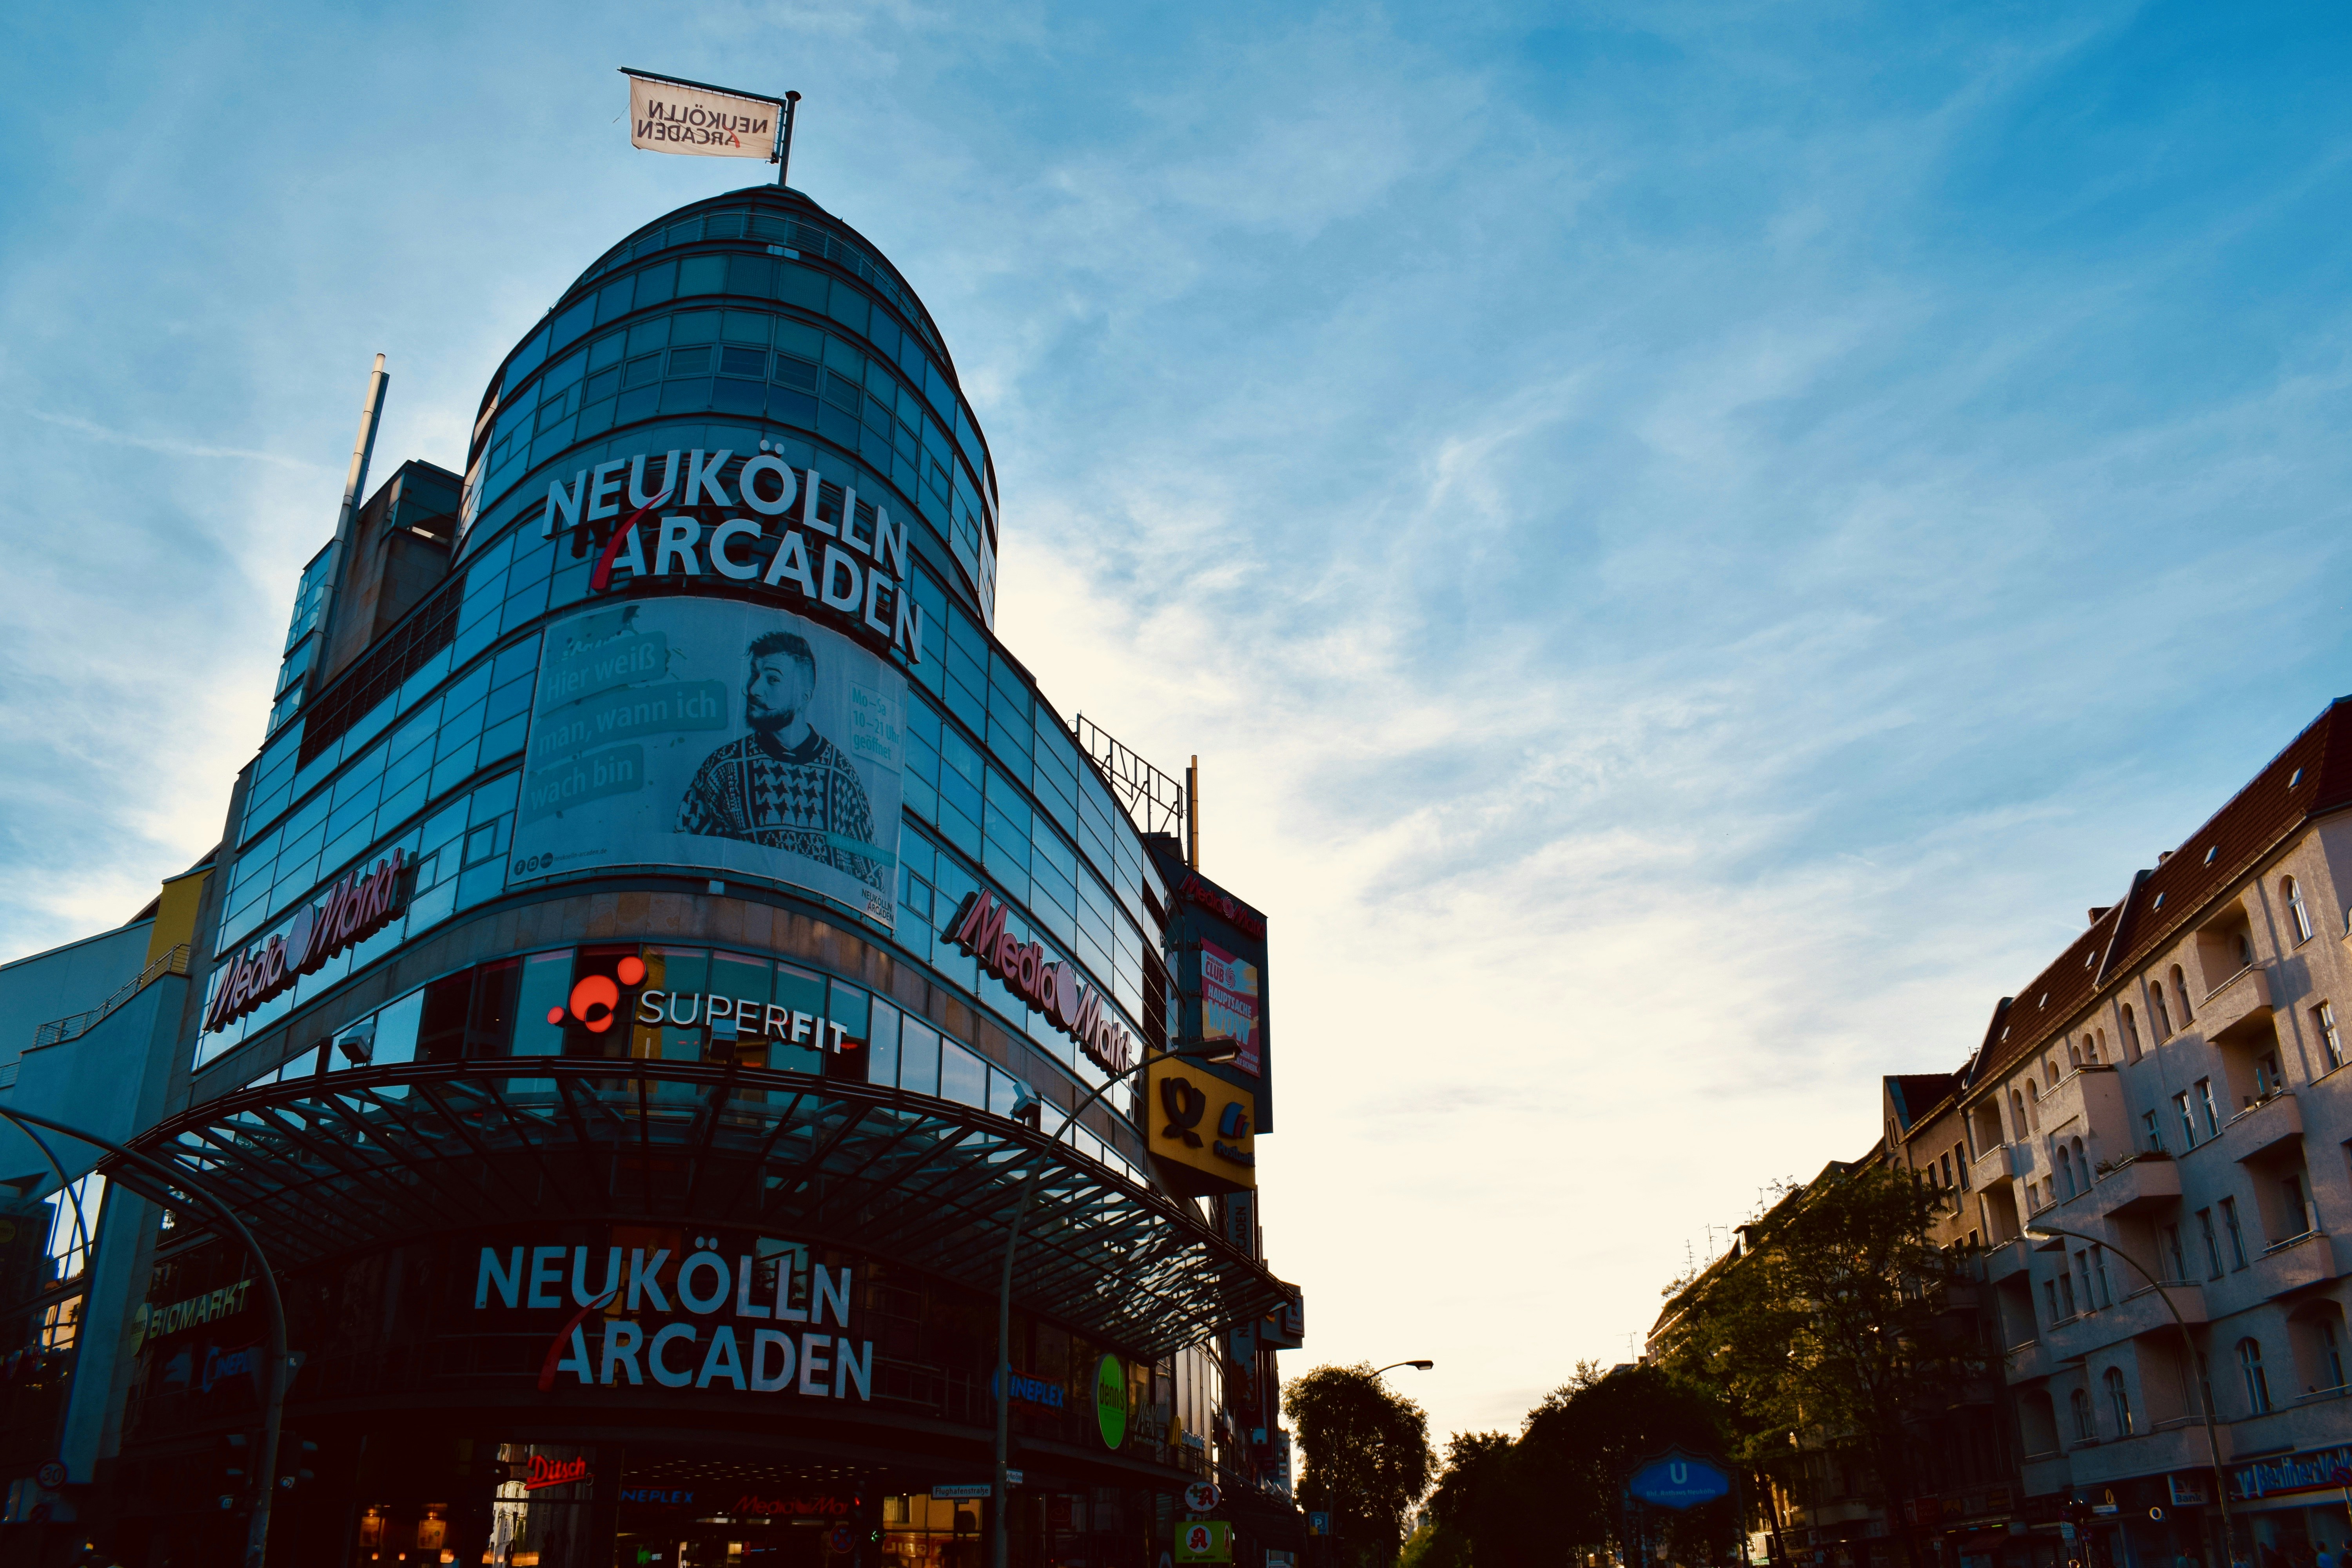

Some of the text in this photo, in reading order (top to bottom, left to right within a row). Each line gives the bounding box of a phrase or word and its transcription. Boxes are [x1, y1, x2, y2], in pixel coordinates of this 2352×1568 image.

[541, 439, 908, 582] NEUKÖLLN
[592, 510, 923, 665] ARCADEN
[545, 642, 655, 703] Hier weiß
[538, 690, 717, 757] man, wann ich
[854, 734, 891, 760] geöffnet
[886, 724, 900, 744] Uhr
[530, 756, 633, 811] wach bin
[862, 888, 892, 912] NEUKÖLLN
[867, 901, 894, 923] ARCADEN
[1179, 873, 1266, 940] Media Markt
[203, 847, 404, 1031] Media Markt
[955, 889, 1132, 1074] Media Markt
[1205, 961, 1225, 983] CLUB
[638, 990, 848, 1054] SUPERFIT
[1208, 984, 1252, 1018] HAUPTSACHE
[1208, 998, 1251, 1045] WOW
[474, 1236, 851, 1328] NEUKÖLLN
[148, 1279, 251, 1340] BIOMARKT
[537, 1317, 873, 1401] ARCADEN
[42, 1466, 62, 1482] 30
[526, 1454, 586, 1484] Ditsch
[935, 1486, 989, 1496] Flughafenstraße
[1670, 1463, 1687, 1485] U
[2175, 1493, 2202, 1503] Bank
